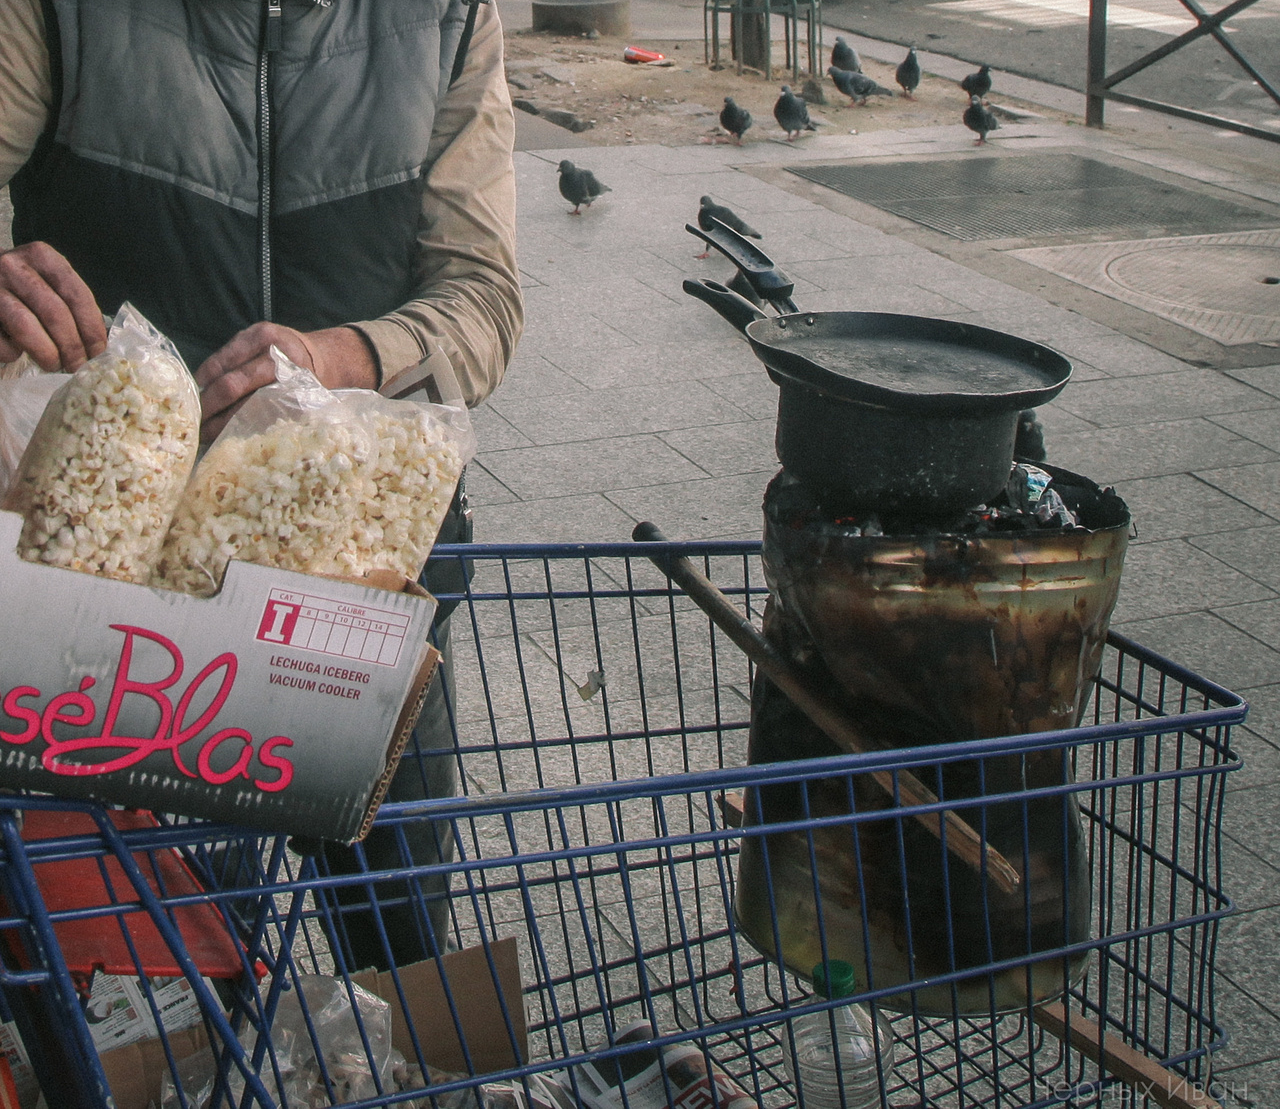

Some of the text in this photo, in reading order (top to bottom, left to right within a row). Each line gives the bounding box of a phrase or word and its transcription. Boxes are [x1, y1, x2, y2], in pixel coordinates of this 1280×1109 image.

[279, 593, 367, 617] CAT. CALIBRE
[263, 602, 294, 642] I
[357, 619, 366, 628] 12
[374, 623, 383, 631] 14
[269, 655, 371, 684] LECHUGA ICEBERG
[269, 672, 361, 700] VACUUM COOLER
